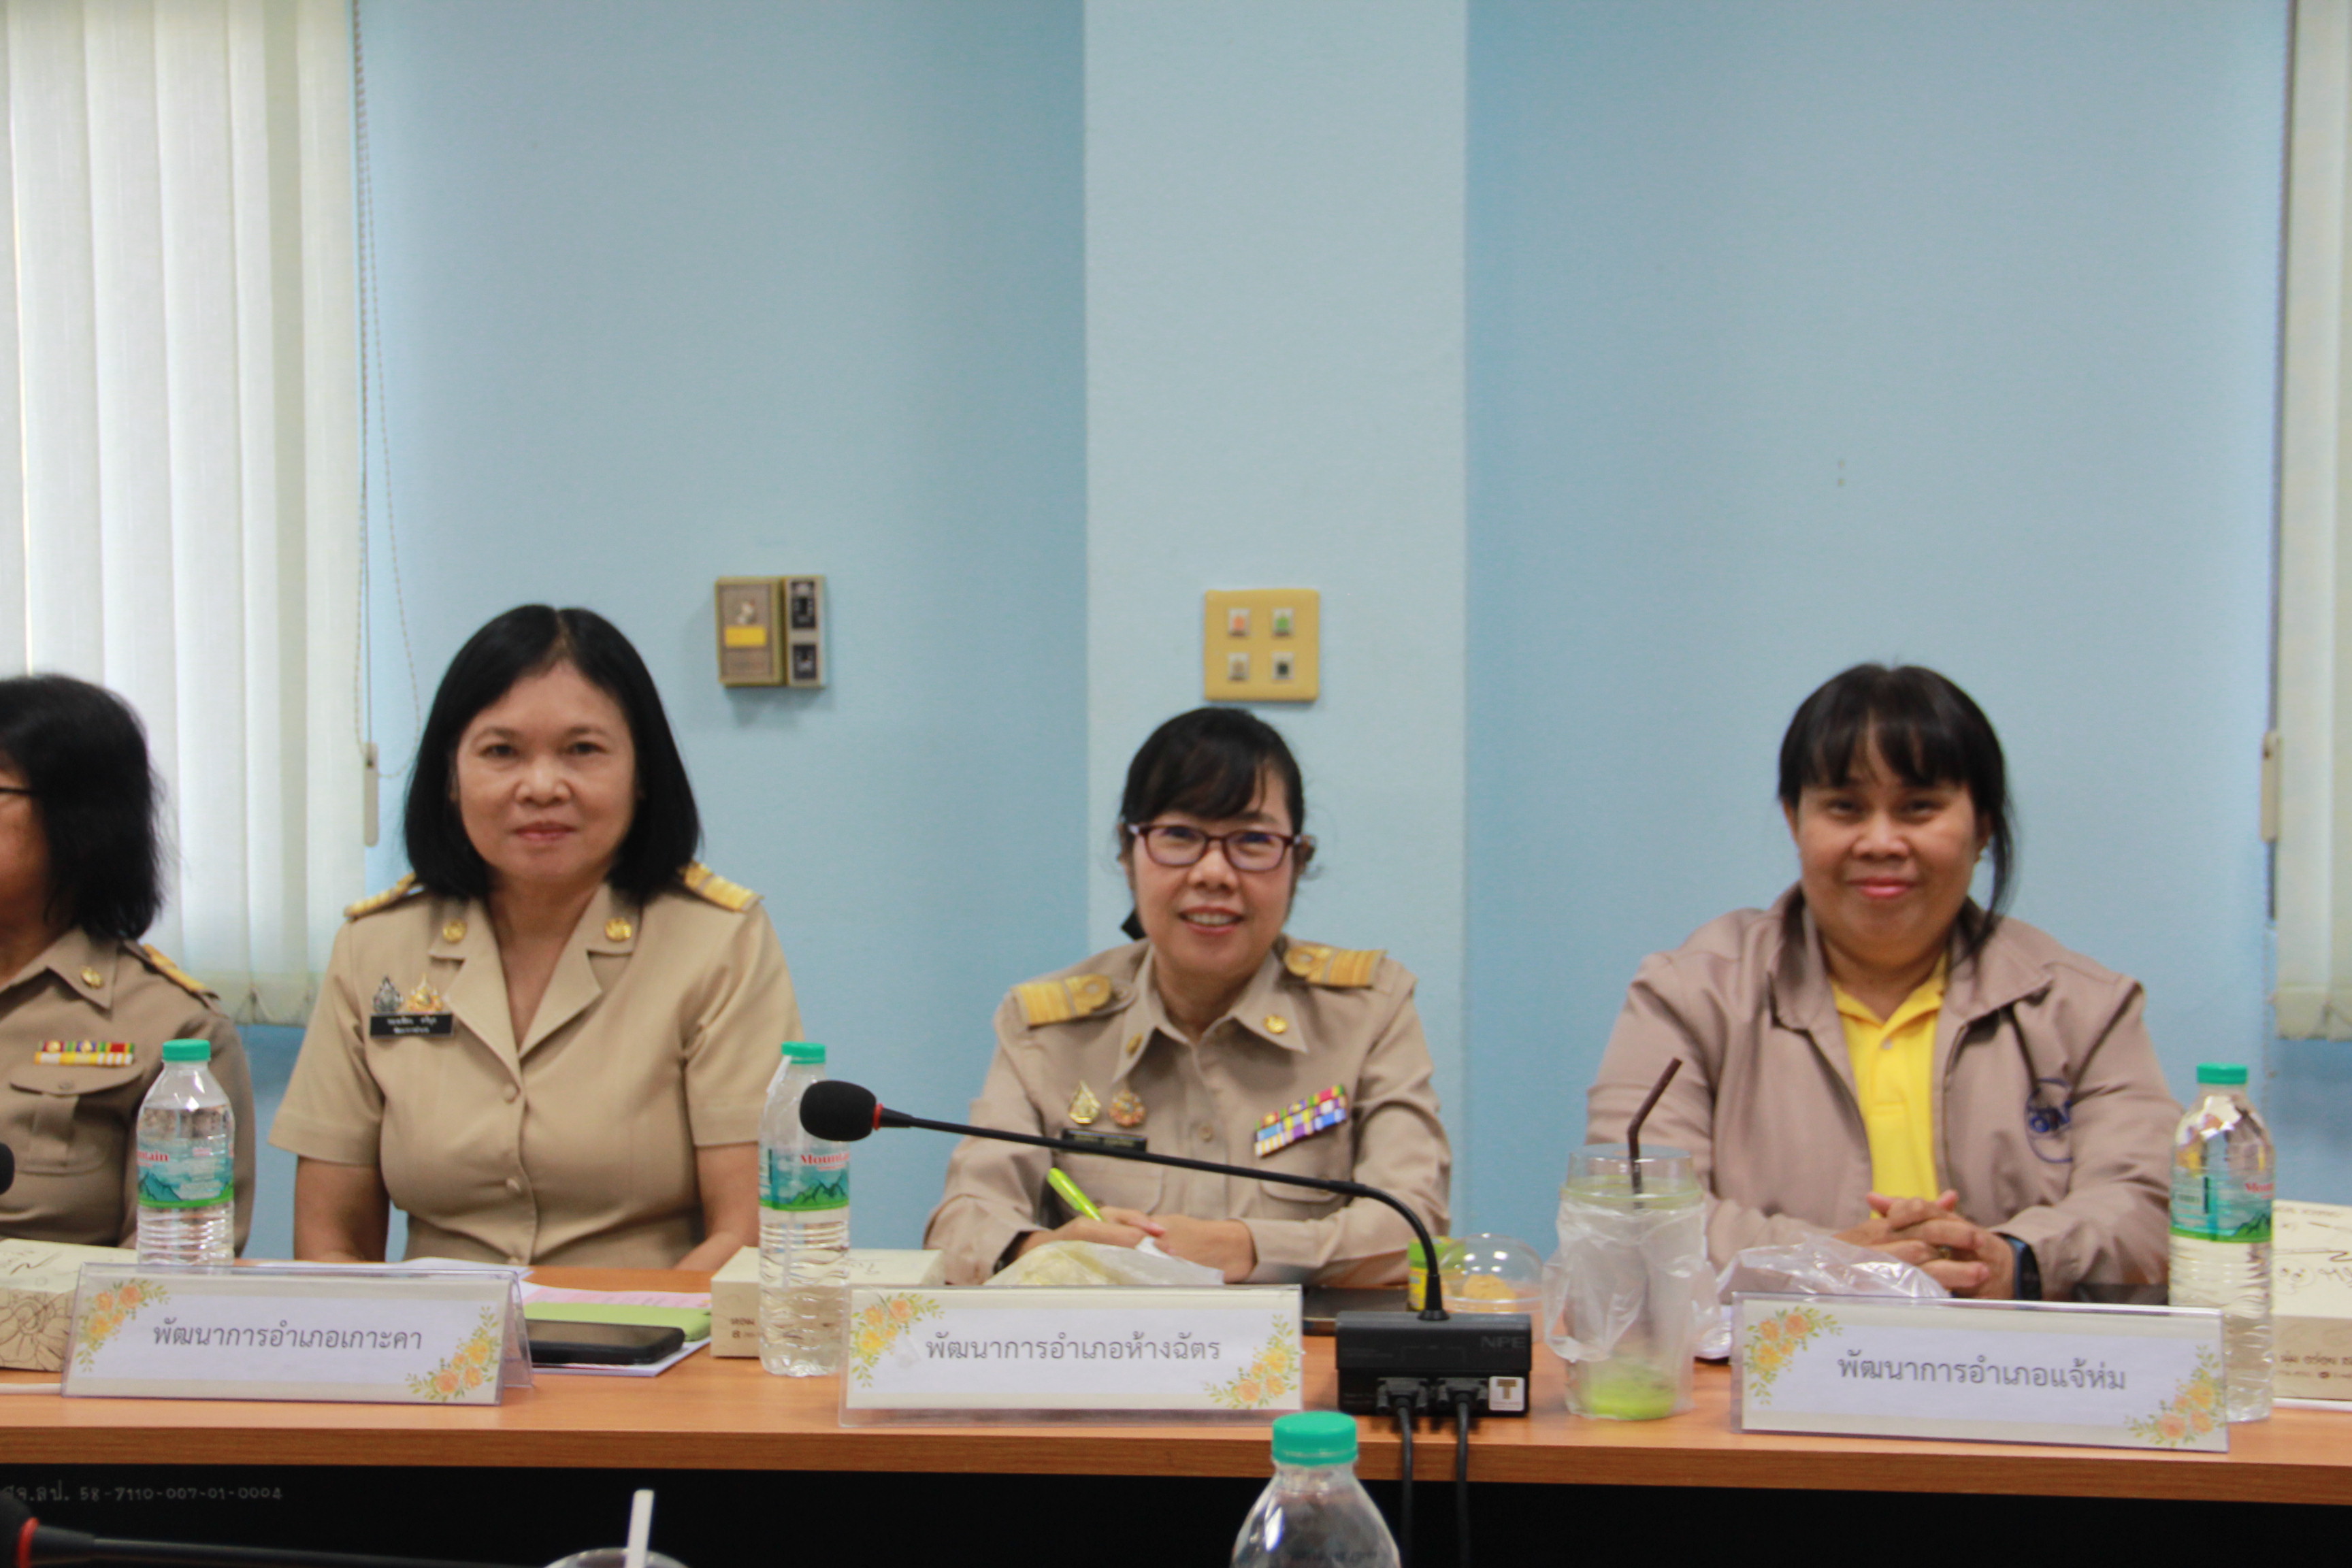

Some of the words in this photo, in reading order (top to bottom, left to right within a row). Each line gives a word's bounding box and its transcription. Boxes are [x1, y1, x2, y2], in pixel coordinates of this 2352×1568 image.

[153, 1316, 423, 1350] พัฒนาการอำเภอเกาะคา
[926, 1329, 1221, 1361] พัฒนาการอำเภอห้างฉัตร
[1838, 1348, 2125, 1390] พัฒนาการอำเภอแจ้ห่ม
